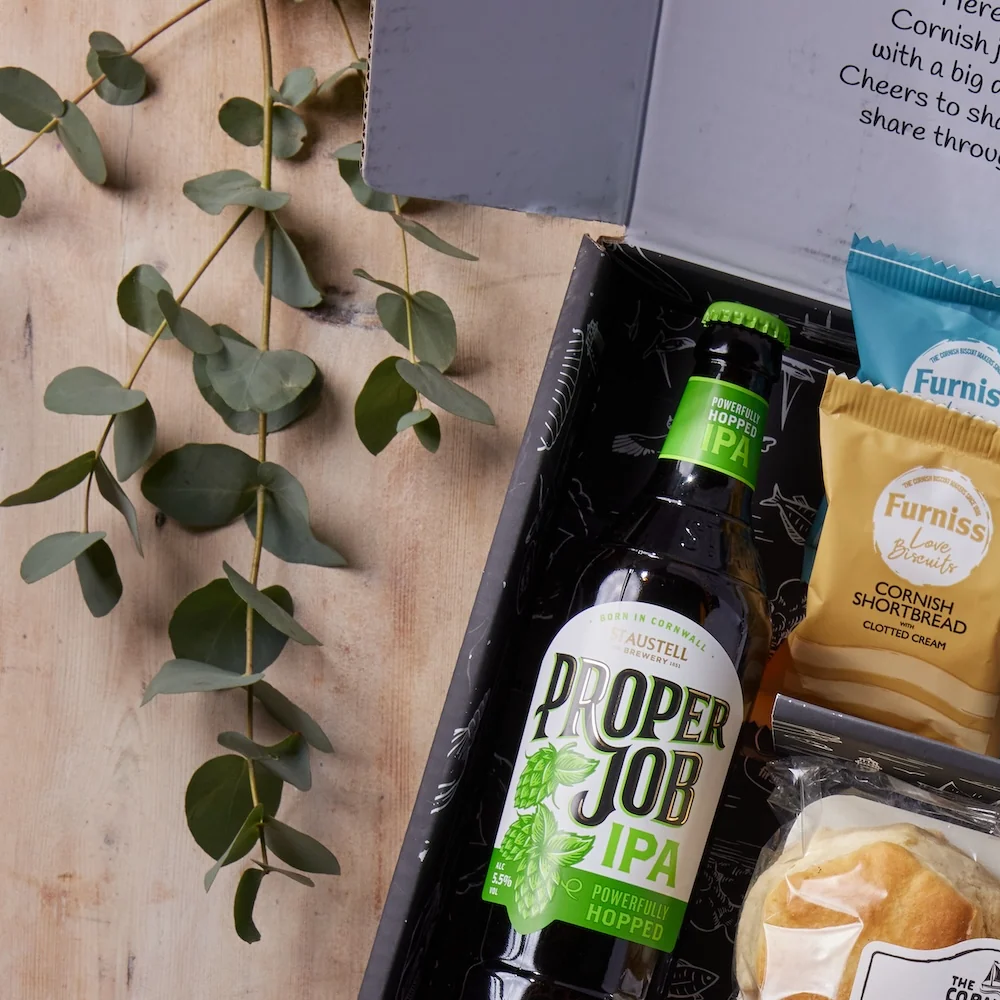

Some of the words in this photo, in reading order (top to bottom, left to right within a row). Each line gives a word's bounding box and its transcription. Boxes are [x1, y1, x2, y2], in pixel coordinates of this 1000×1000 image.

[892, 9, 989, 55] Cornish
[872, 42, 923, 71] with
[930, 61, 943, 78] a
[951, 60, 983, 94] big
[840, 65, 928, 107] Cheers
[936, 92, 960, 116] to
[859, 107, 925, 140] share
[708, 409, 757, 438] HOPPED
[712, 397, 760, 424] POWERFULLY
[701, 423, 750, 468] IPA
[884, 492, 986, 543] Furniss
[888, 539, 958, 574] Biscuits
[910, 526, 951, 553] Love
[852, 591, 967, 635] SHORTBREAD
[875, 582, 954, 615] CORNISH
[600, 612, 628, 622] BORN
[634, 614, 646, 622] IN
[651, 617, 707, 652] CORNWALL
[625, 632, 688, 661] AUSTELL
[863, 620, 910, 640] CLOTTED
[911, 633, 947, 651] CREAM
[624, 647, 668, 665] BREWERY
[531, 652, 731, 752] PROPER
[569, 745, 703, 828] JOB
[601, 822, 680, 888] IPA
[591, 884, 669, 921] POWERFULLY
[586, 903, 664, 942] HOPPED
[951, 976, 976, 991] THE
